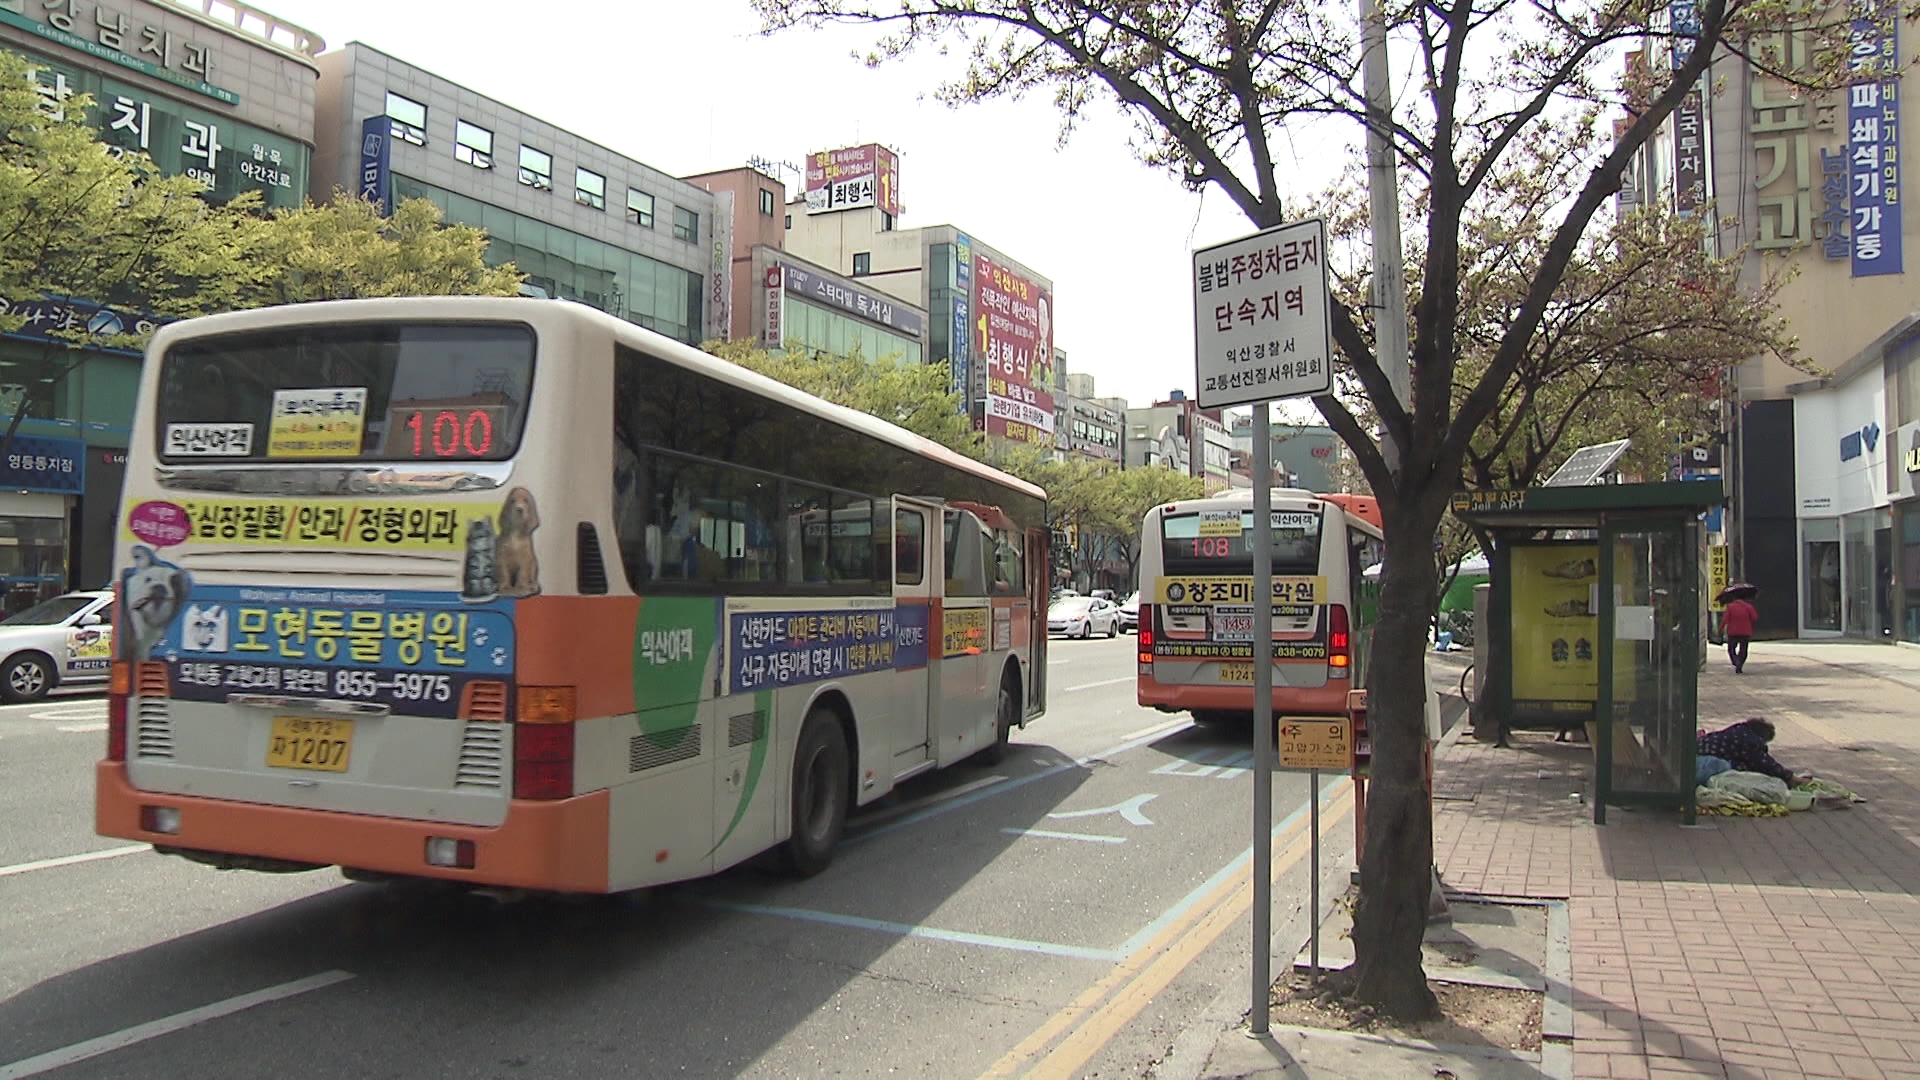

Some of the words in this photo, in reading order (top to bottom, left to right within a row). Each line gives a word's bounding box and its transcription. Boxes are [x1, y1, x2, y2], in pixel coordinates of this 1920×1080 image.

[36, 24, 86, 50] Gangnam
[87, 42, 120, 61] Dental
[1851, 117, 1881, 197] 쇄석기
[240, 161, 292, 189] 야간진료
[360, 161, 378, 202] IBK
[824, 180, 833, 209] 1
[835, 179, 874, 205] 최행식
[1854, 205, 1883, 260] 가동
[993, 268, 1028, 300] 익산시장
[817, 280, 854, 309] 스터디빌
[857, 293, 893, 325] 독서실
[1215, 285, 1303, 332] 단속지역
[988, 337, 1028, 380] 최행식
[1226, 338, 1295, 363] 익산경찰서
[1205, 358, 1321, 392] 교통선진질서위원회
[171, 428, 249, 453] 익산여객
[407, 410, 492, 456] 100
[8, 454, 73, 473] 영등동지점
[1904, 448, 1920, 473] ML
[1500, 490, 1526, 503] APT
[1500, 500, 1523, 511] APT
[1271, 514, 1313, 527] 익산여객
[1191, 537, 1230, 558] 108
[1188, 582, 1315, 603] 창조미학원
[234, 606, 470, 668] 모현동물병원
[740, 615, 787, 650] 신한카드
[1219, 617, 1254, 632] 143
[641, 628, 693, 665] 익산여객
[740, 655, 765, 688] 신규
[767, 651, 811, 682] 자동이체
[812, 647, 832, 677] 연결
[833, 645, 843, 672] 시
[335, 668, 451, 702] 855-5975
[1283, 742, 1346, 755] 고압가스관
